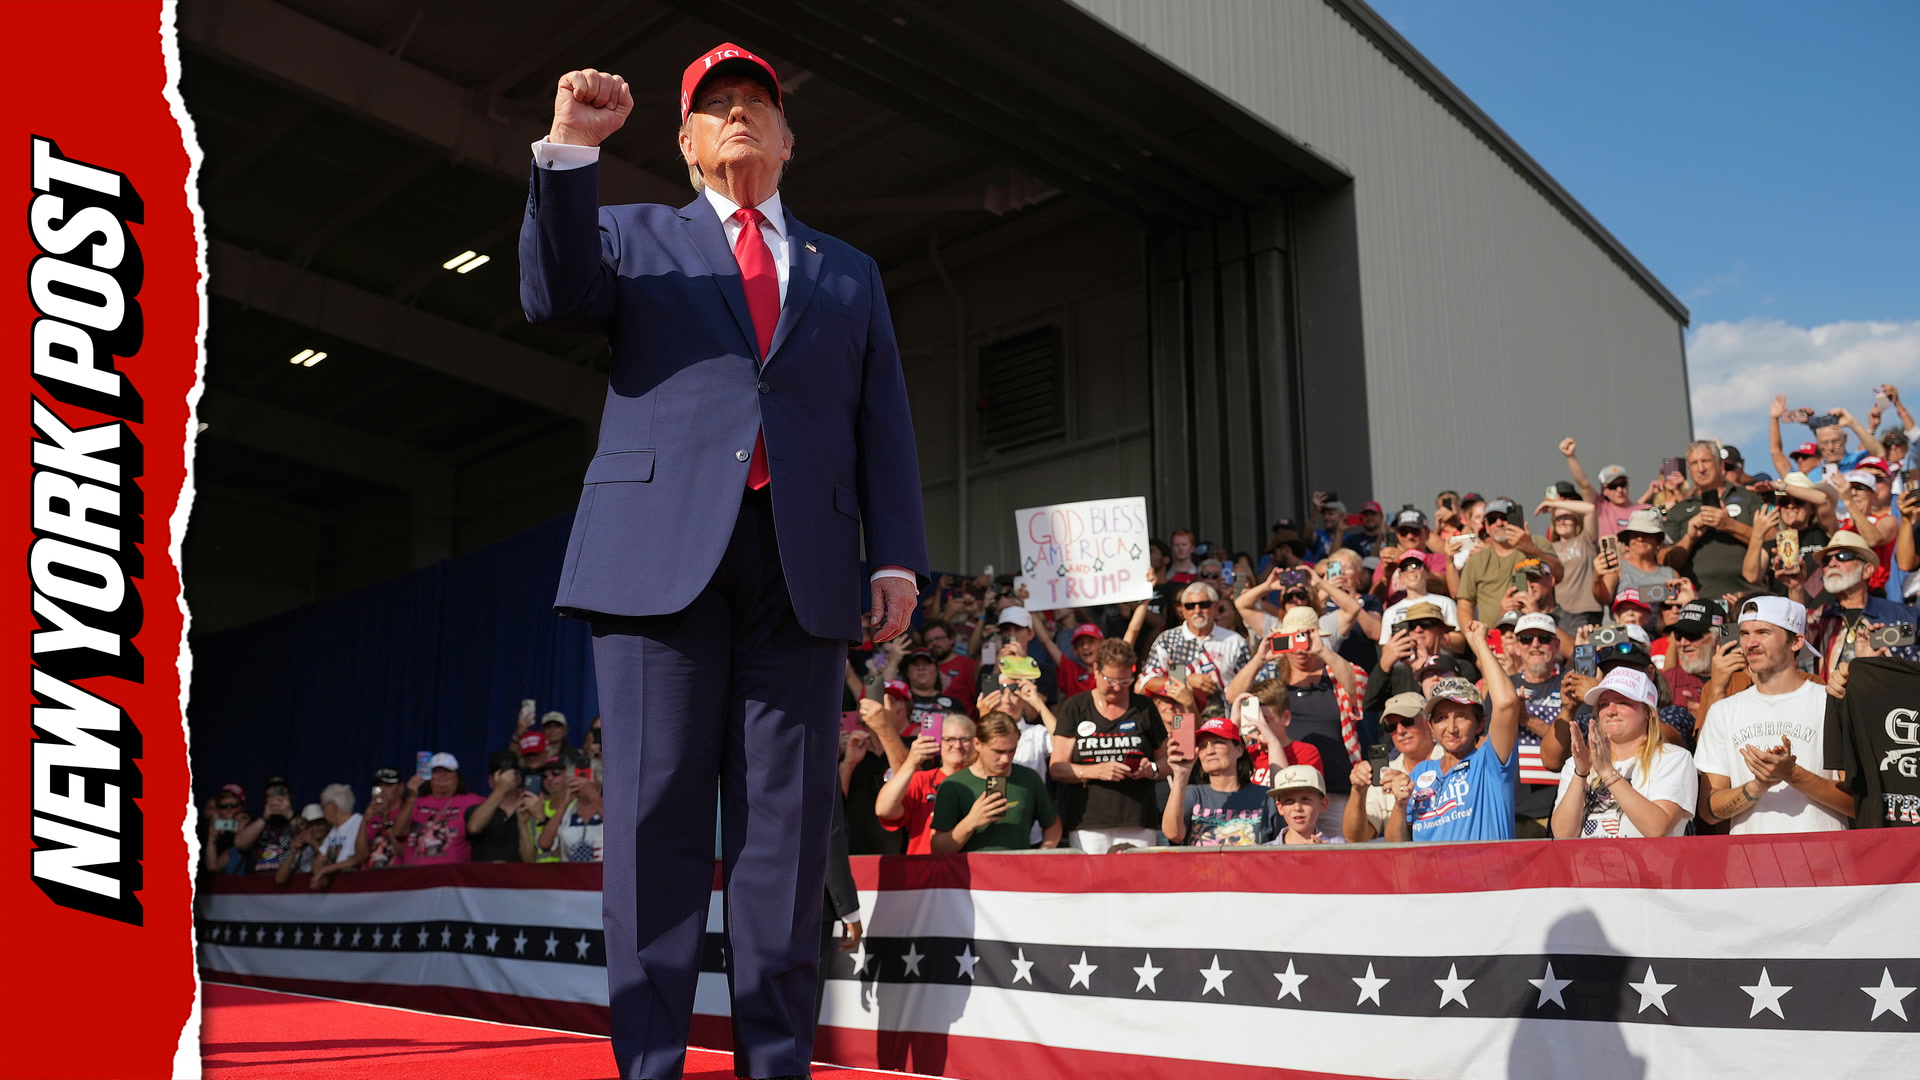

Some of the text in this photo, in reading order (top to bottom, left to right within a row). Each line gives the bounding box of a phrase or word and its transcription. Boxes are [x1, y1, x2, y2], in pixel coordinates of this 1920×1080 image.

[1028, 503, 1145, 546] GOD BLESS
[1033, 536, 1129, 569] AMERICA
[1067, 564, 1092, 574] AND
[1047, 568, 1132, 604] TRUMP
[1076, 736, 1142, 750] TRUMP
[1732, 720, 1817, 748] AMERICAN
[1423, 815, 1451, 830] America
